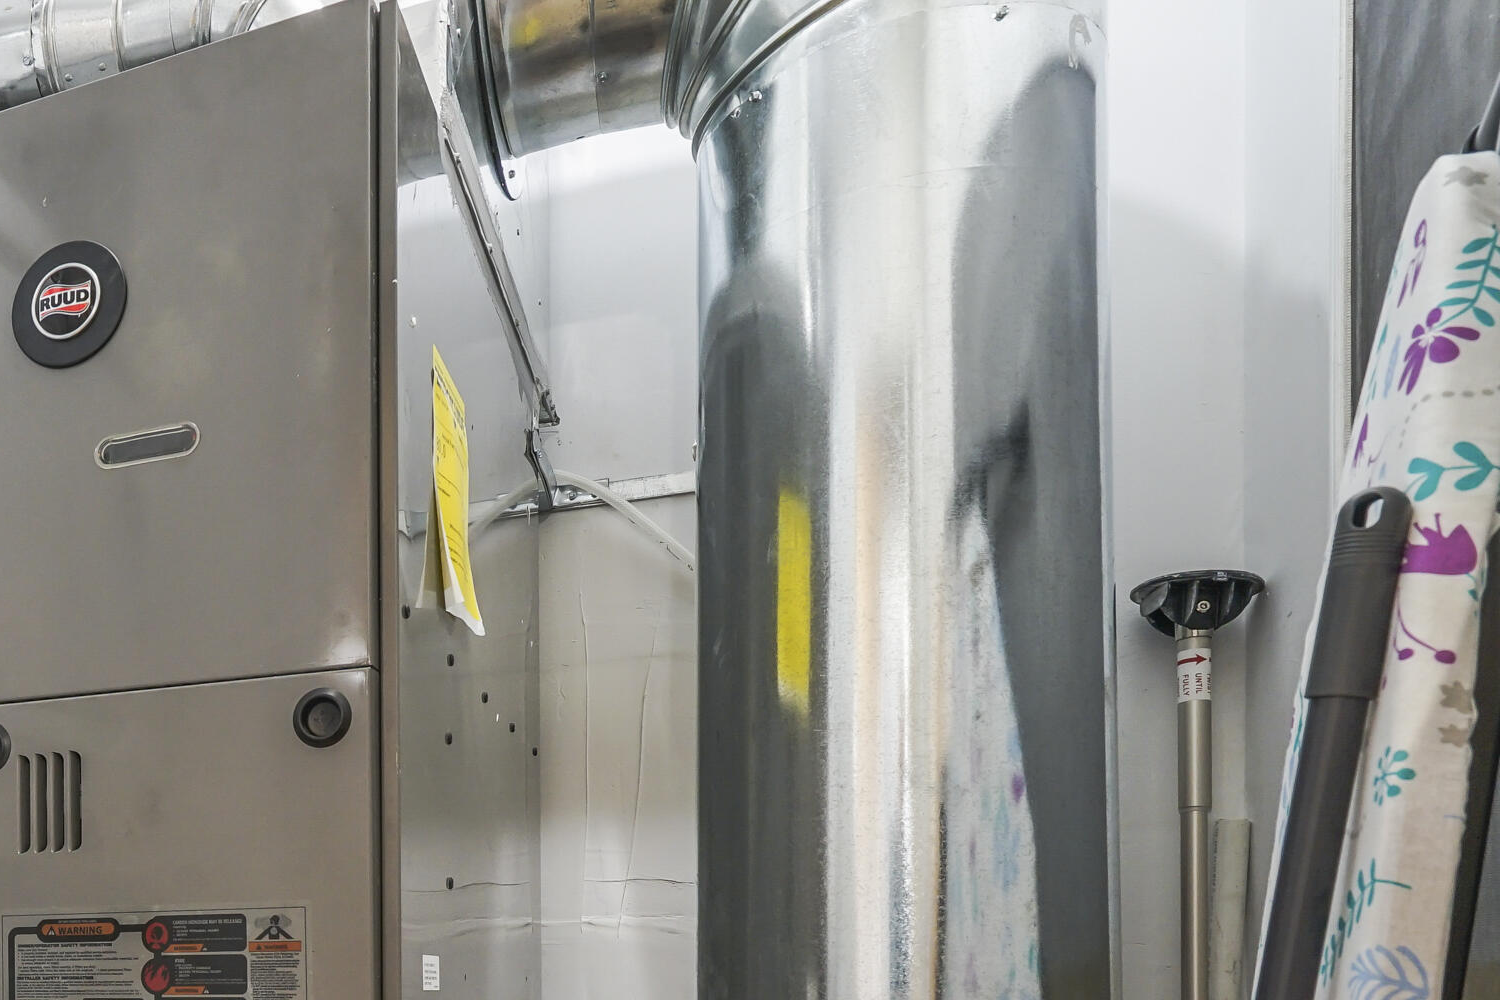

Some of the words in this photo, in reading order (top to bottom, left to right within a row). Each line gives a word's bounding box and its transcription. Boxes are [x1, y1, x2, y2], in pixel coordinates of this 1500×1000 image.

[40, 289, 89, 312] RUUD
[1182, 674, 1190, 696] FULLY
[58, 926, 102, 935] WARNING
